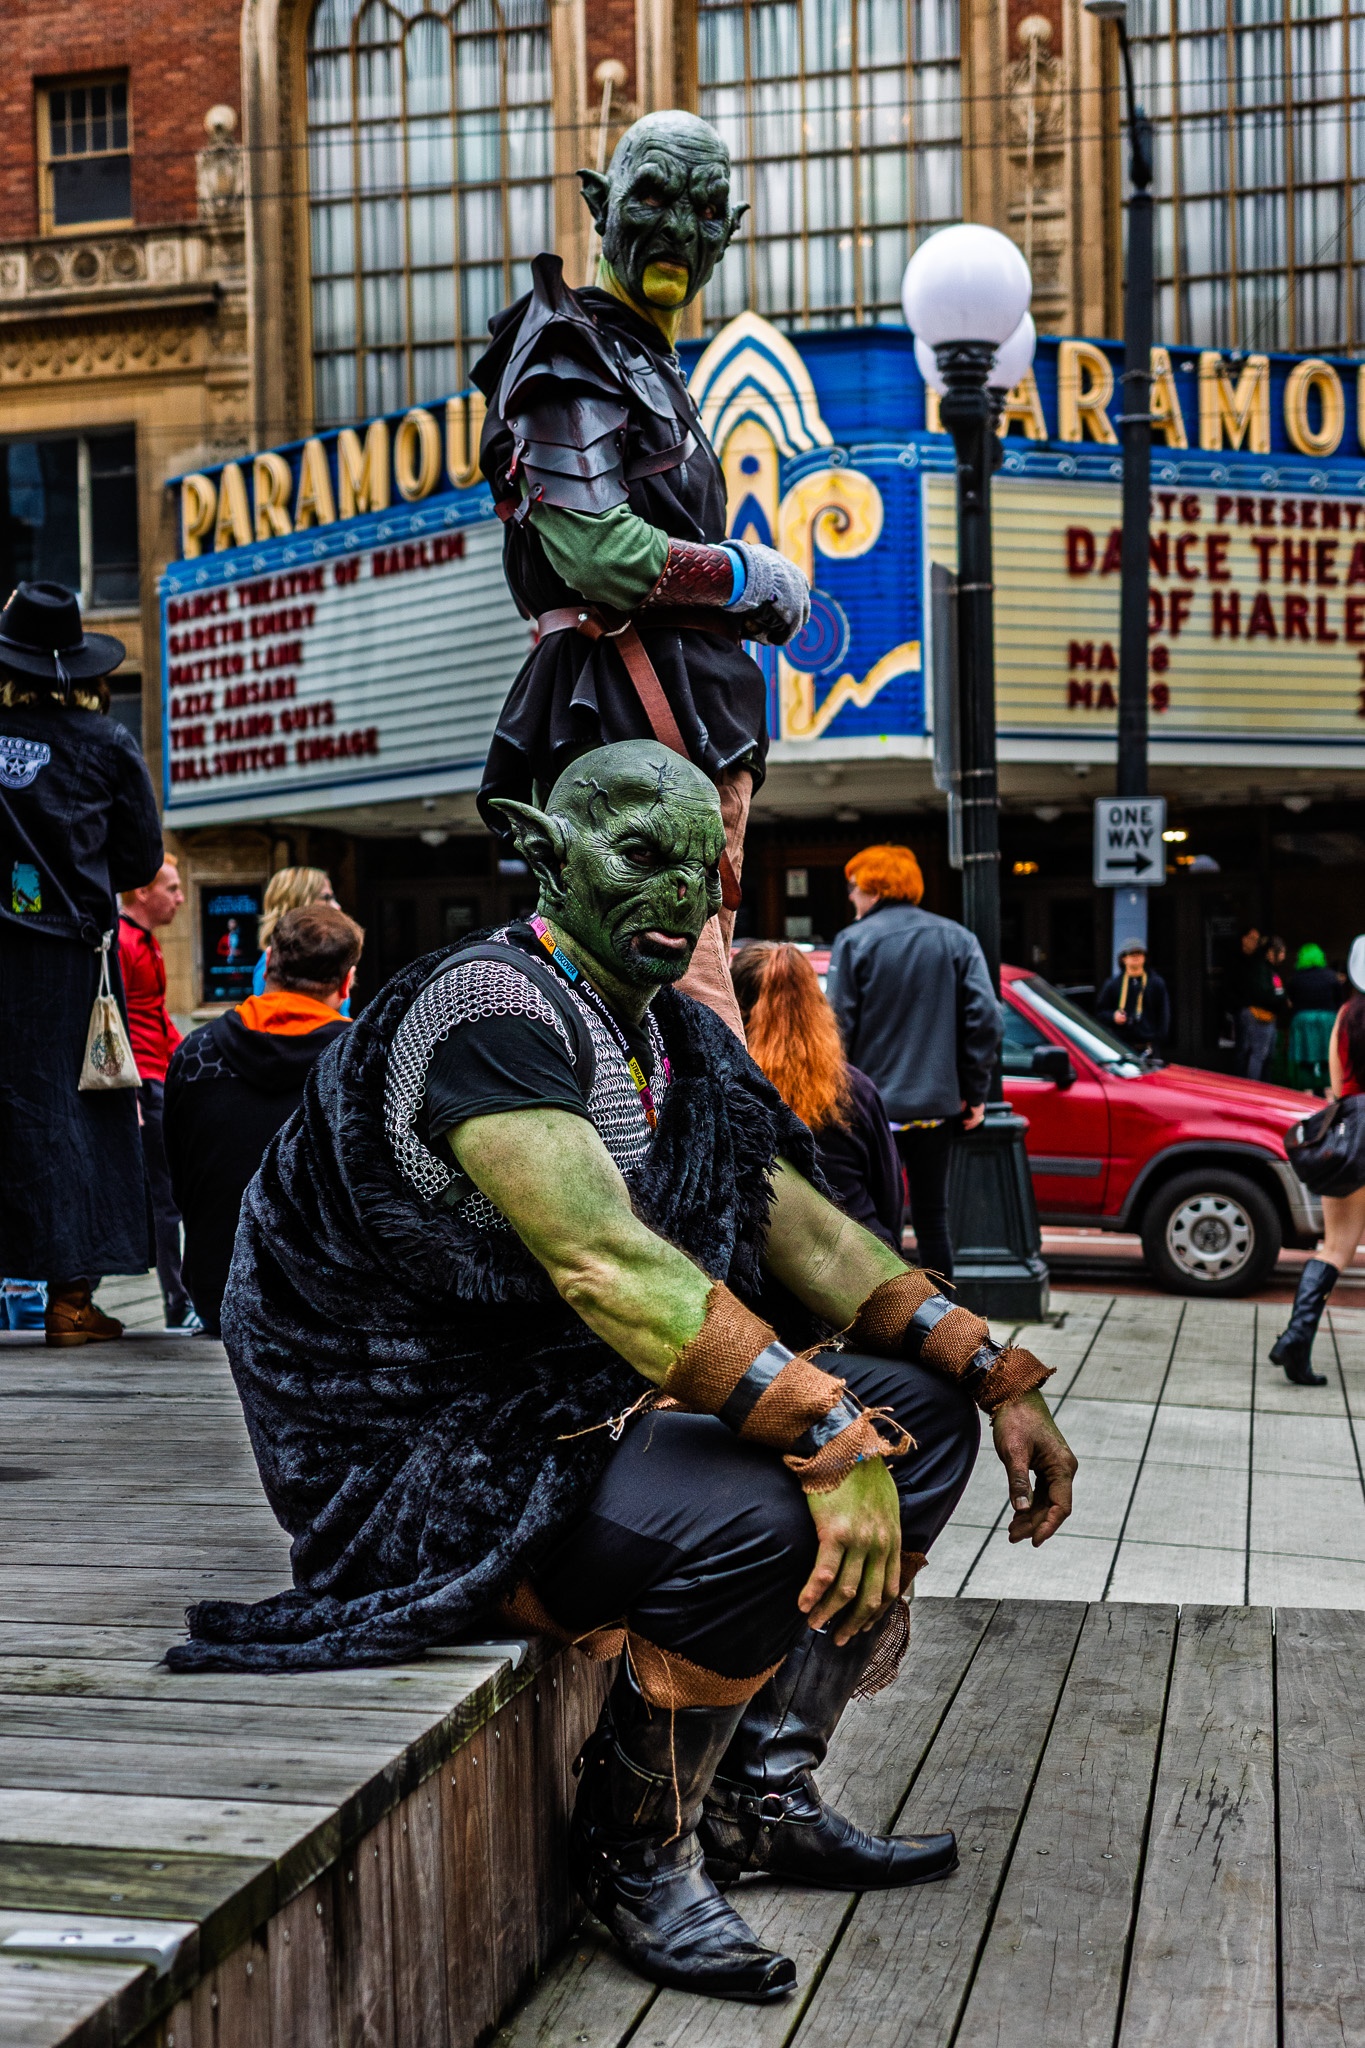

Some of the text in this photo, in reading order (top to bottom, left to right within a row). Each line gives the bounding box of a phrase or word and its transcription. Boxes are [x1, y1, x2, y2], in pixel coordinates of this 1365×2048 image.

[926, 340, 1365, 457] ARAMO
[1150, 492, 1201, 524] TG
[1066, 526, 1231, 582] DANCE
[168, 531, 467, 625] DANCE THEATRE OF HARLEM
[169, 604, 316, 657] GARETH EMERY
[169, 653, 244, 688] MATTEO
[1068, 640, 1117, 672] MA
[171, 675, 298, 719] AZIZ ANSARI
[1067, 679, 1117, 710] MA
[170, 700, 336, 750] THE PIANO GUYS
[170, 726, 380, 783] KILLSWITCH ENGAGE
[1109, 805, 1153, 827] ONE
[1108, 827, 1154, 849] WAY
[542, 933, 555, 949] SHOP
[554, 949, 577, 976] DISCOVER
[580, 980, 629, 1051] FUNIMATION
[630, 1061, 646, 1086] STREAM
